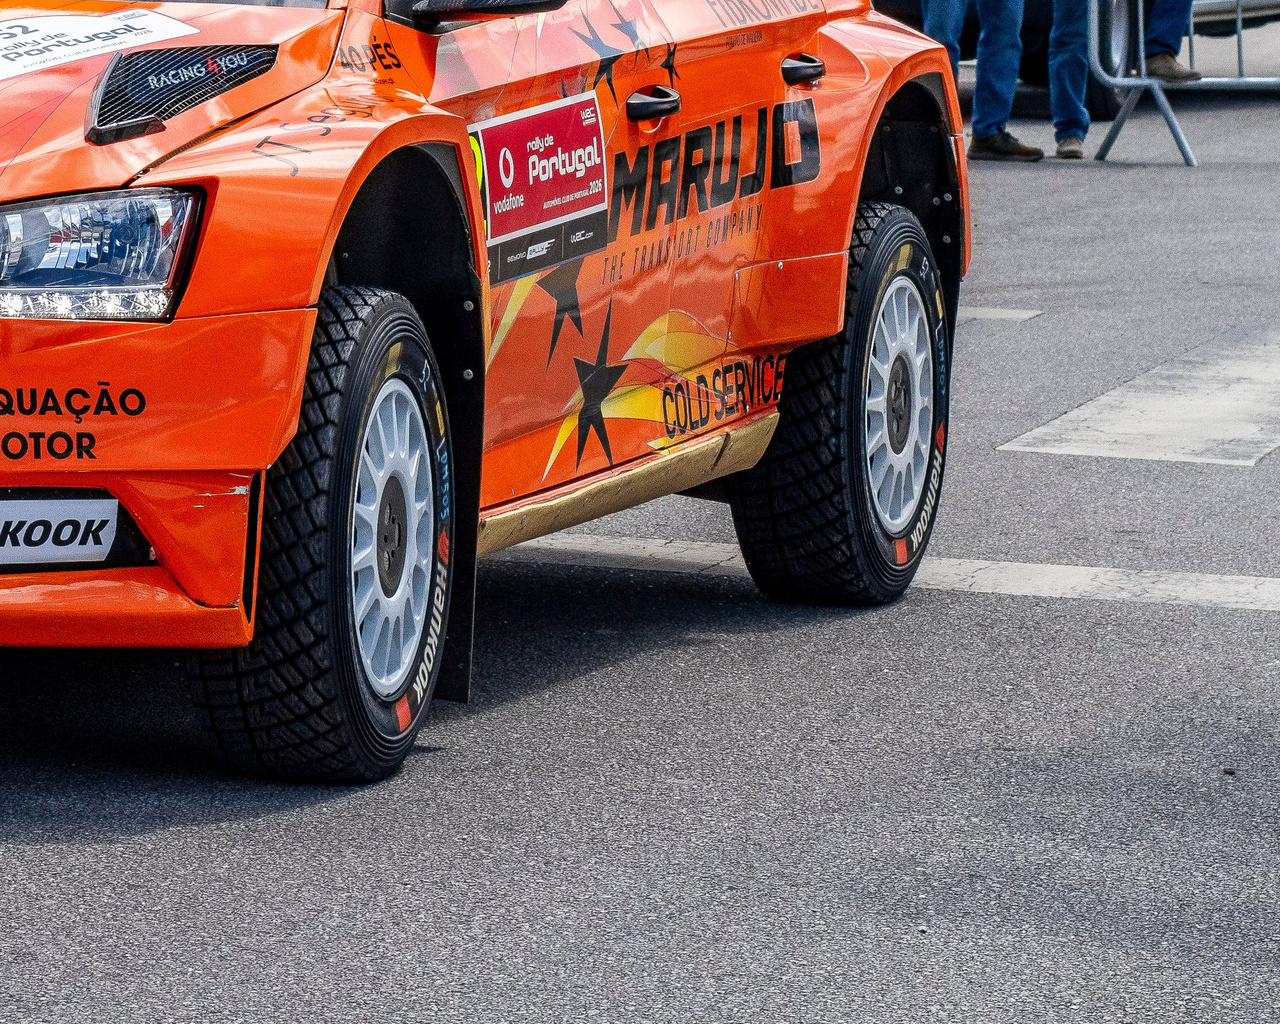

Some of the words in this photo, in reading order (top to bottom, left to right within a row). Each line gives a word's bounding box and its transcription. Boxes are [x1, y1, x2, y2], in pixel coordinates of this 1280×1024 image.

[40, 31, 70, 42] de
[339, 45, 366, 74] 40
[363, 34, 402, 71] PÉS
[251, 135, 312, 178] JT
[526, 136, 546, 153] rally
[544, 133, 555, 147] de
[528, 136, 602, 186] Portugal
[589, 178, 603, 195] 2026
[606, 97, 821, 245] MARUJO
[493, 192, 525, 215] vodafone
[601, 251, 626, 285] THE
[706, 204, 763, 249] COMPANY
[662, 374, 710, 440] COLD
[712, 354, 787, 421] SERVICE
